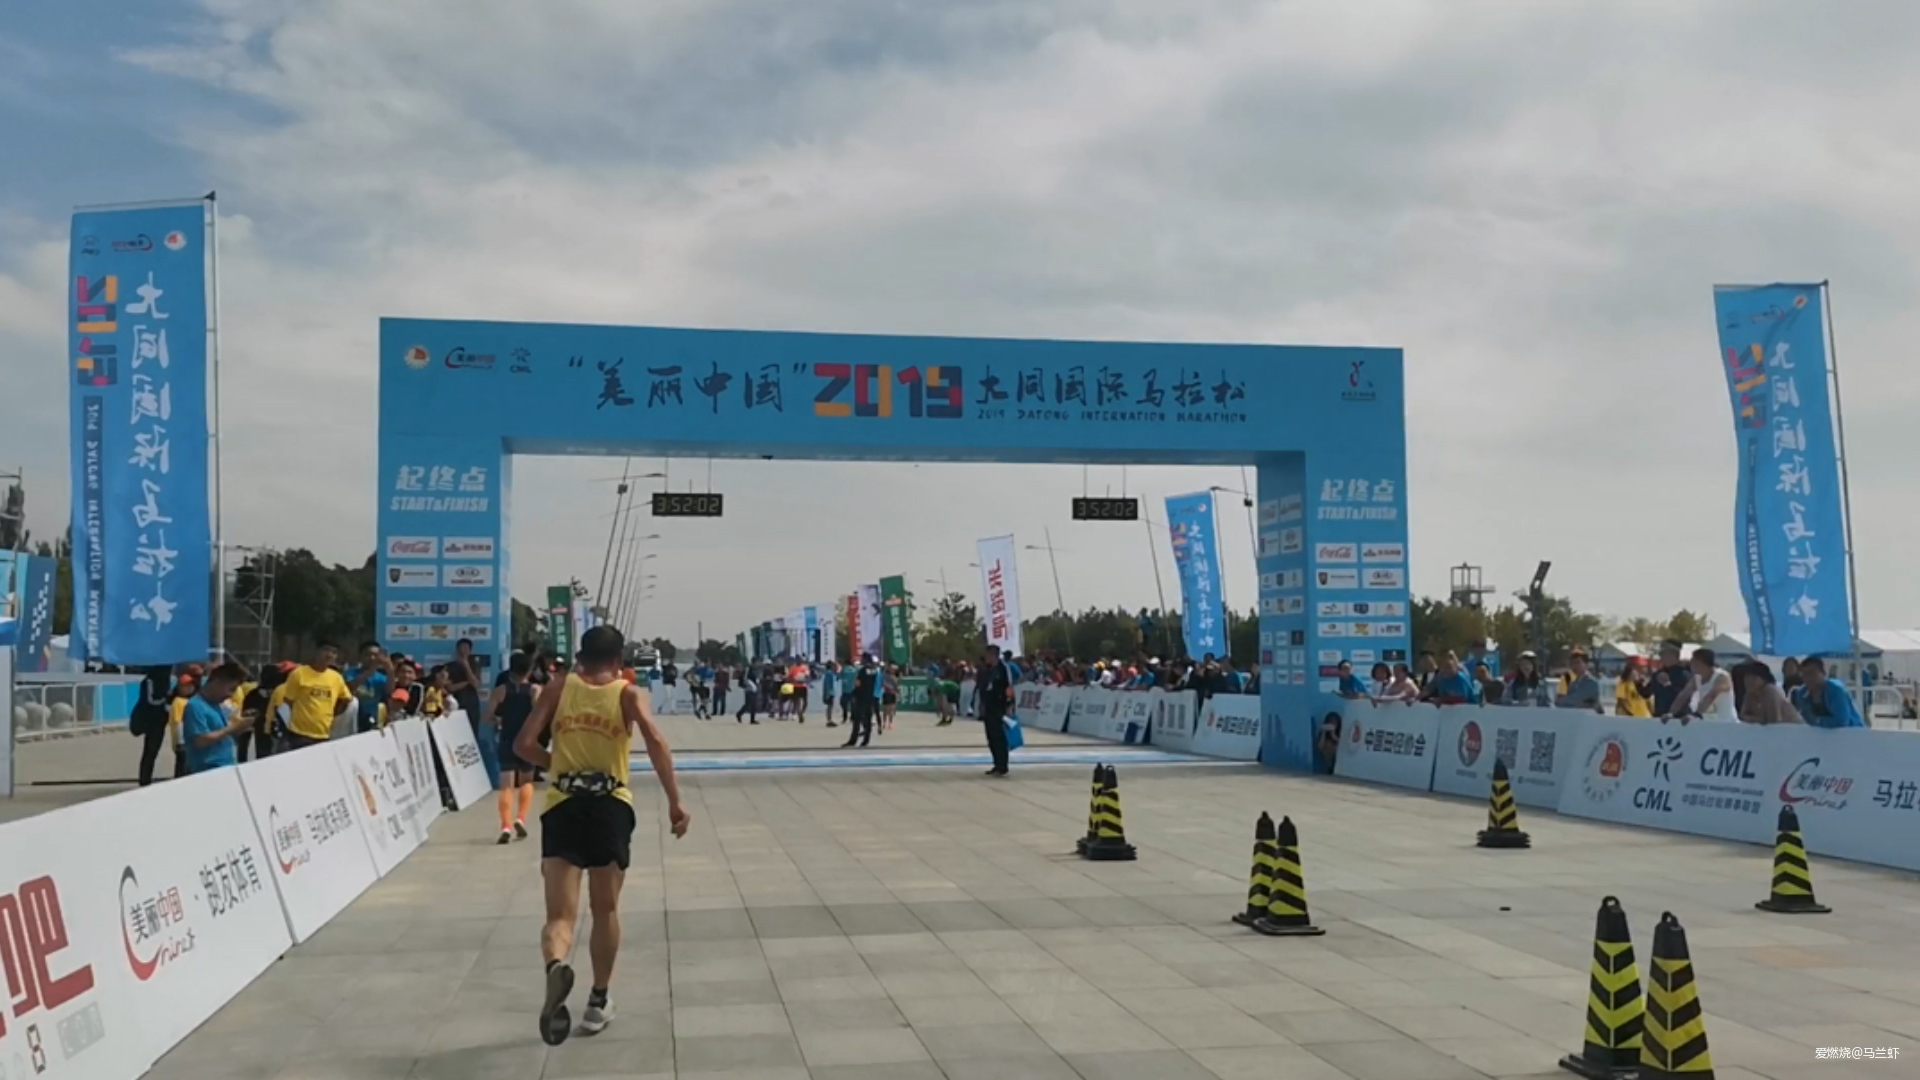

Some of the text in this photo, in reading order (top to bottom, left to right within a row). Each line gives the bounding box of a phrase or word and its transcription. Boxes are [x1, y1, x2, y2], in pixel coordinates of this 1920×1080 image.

[813, 362, 964, 419] 2019
[975, 364, 1247, 410] 大同国际马拉松
[1016, 409, 1070, 421] DATONG
[1080, 409, 1166, 422] INTERNATION
[1176, 411, 1247, 424] MARATHON
[395, 464, 488, 492] 起终点
[1320, 478, 1396, 502] 起终点
[1700, 747, 1756, 779] CML
[1632, 786, 1673, 812] CML
[1872, 779, 1920, 811] 马拉
[130, 886, 184, 945] 美丽中国
[0, 874, 94, 1020] 吧
